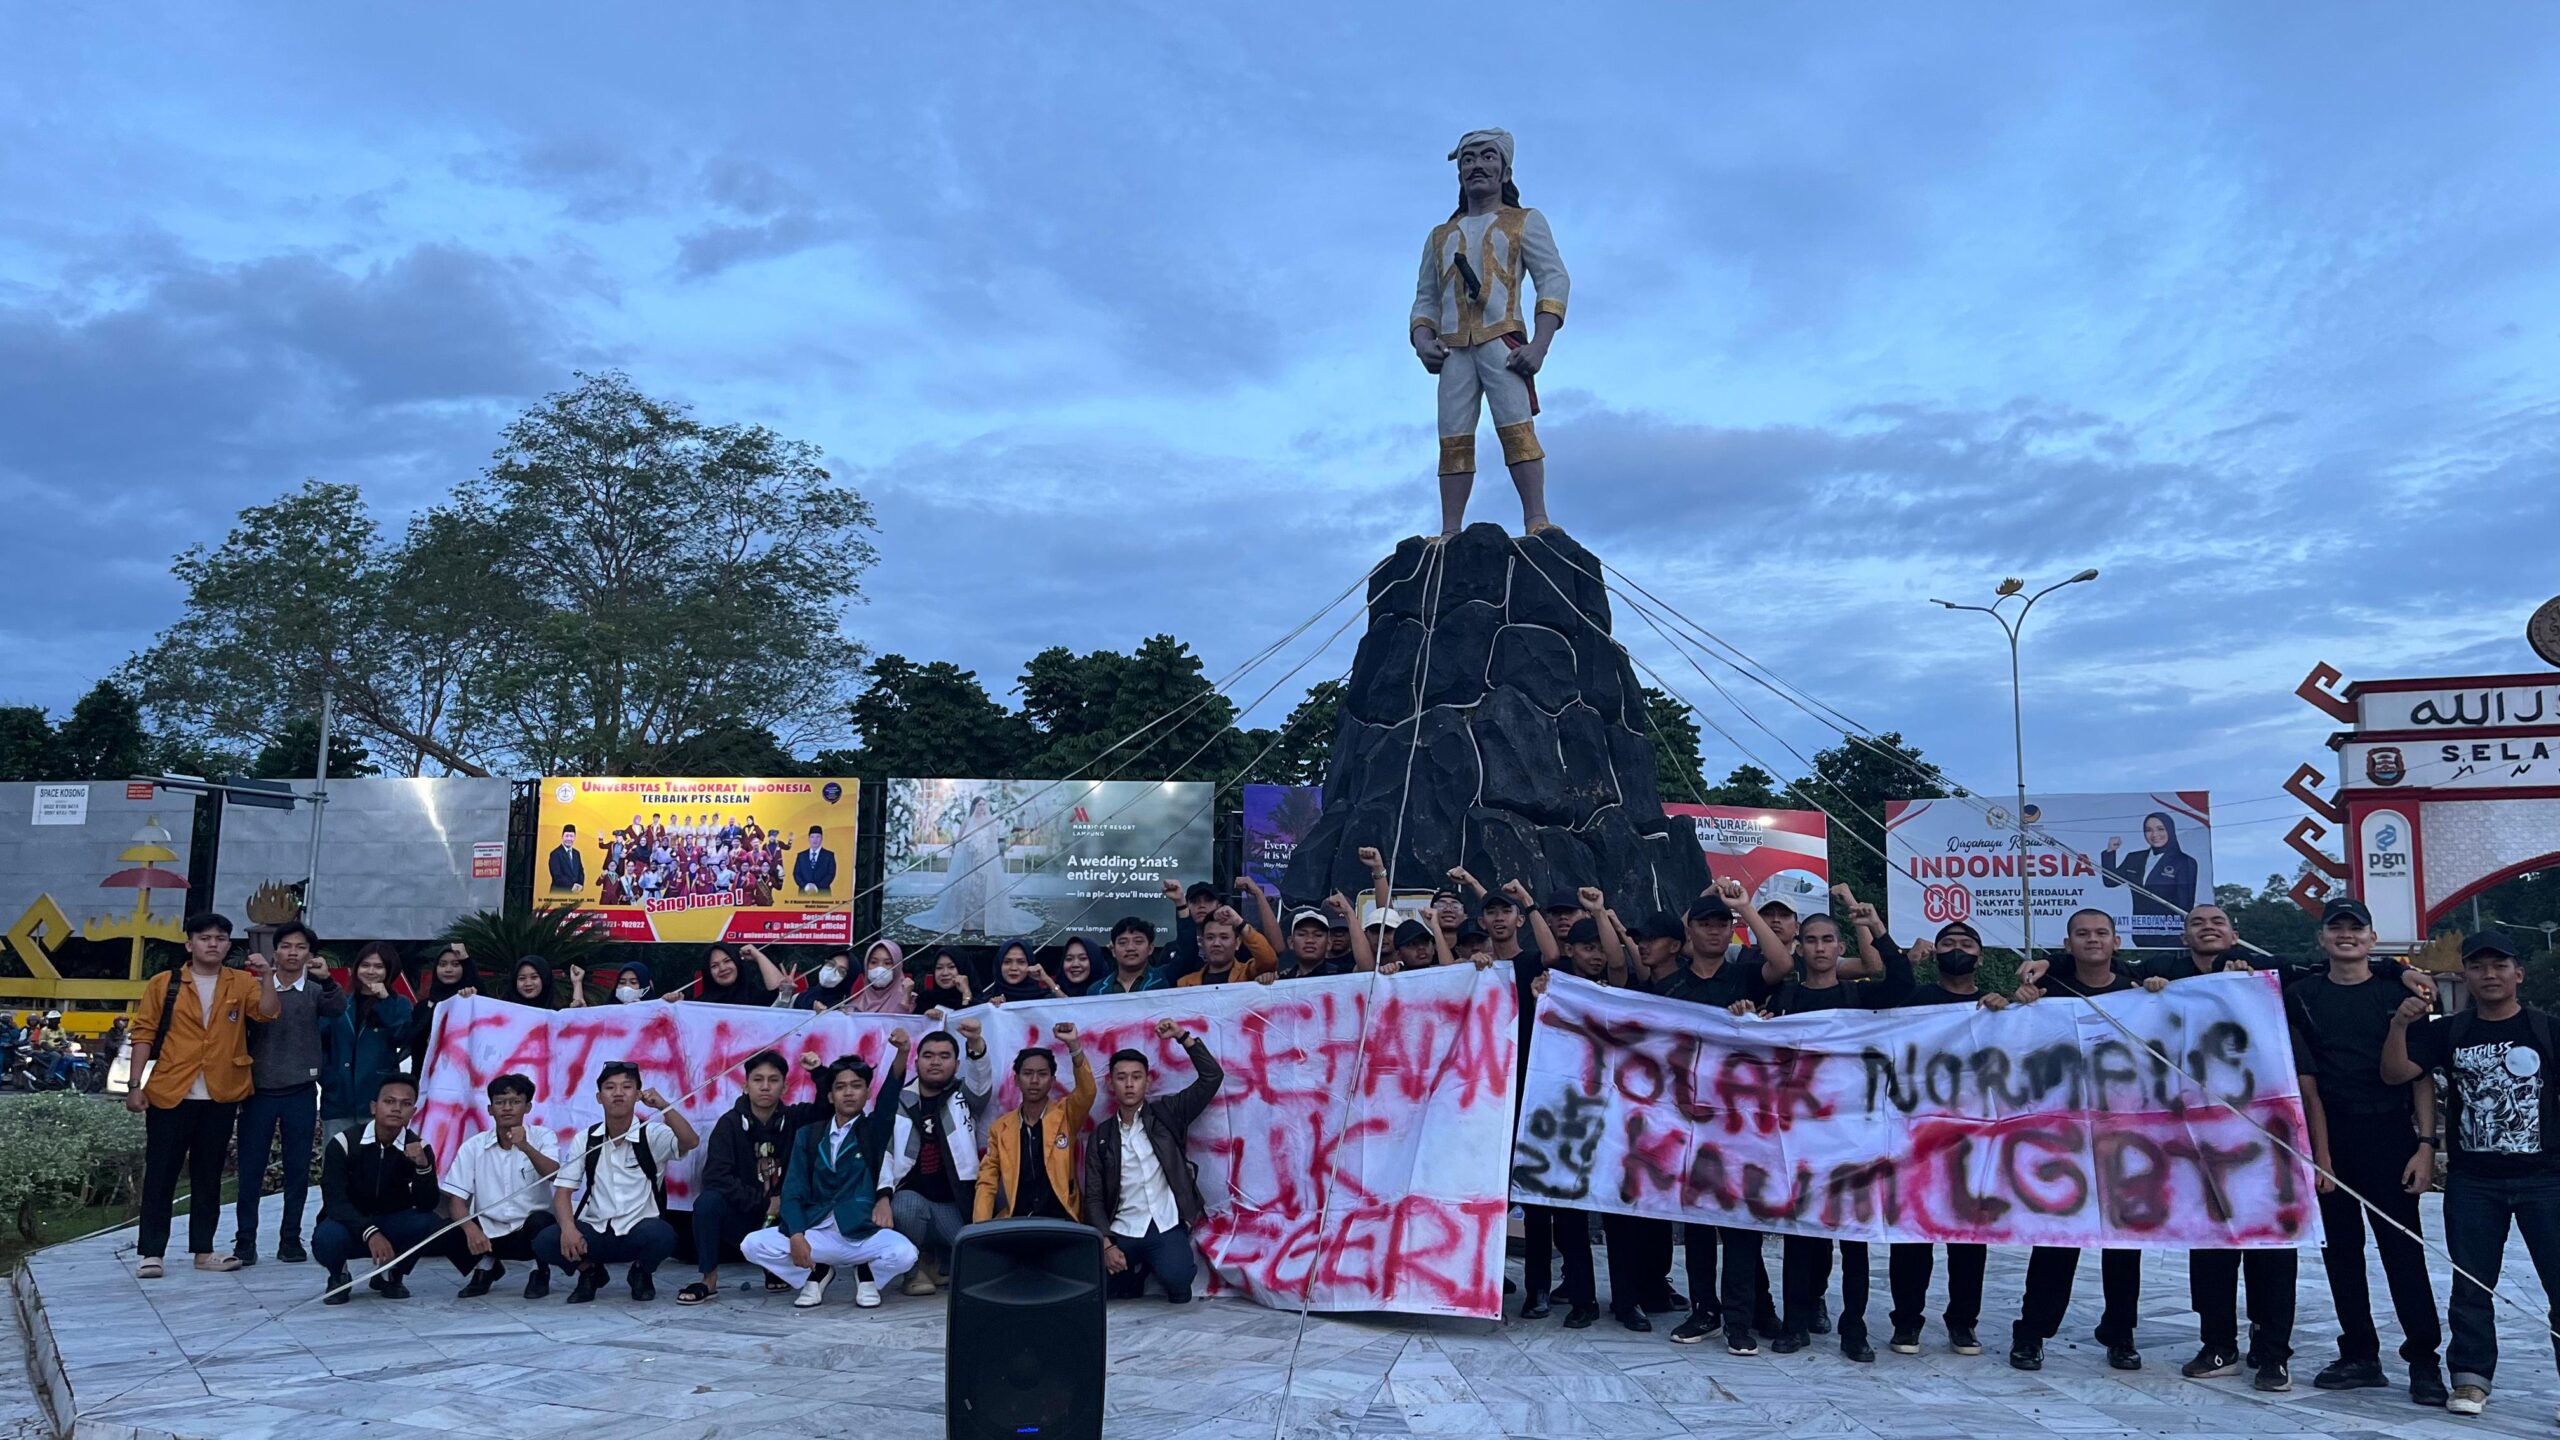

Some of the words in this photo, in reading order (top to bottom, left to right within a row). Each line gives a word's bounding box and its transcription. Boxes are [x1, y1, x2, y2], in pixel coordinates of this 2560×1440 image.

[40, 788, 59, 798] SPACE
[60, 788, 86, 798] KOSONG
[582, 782, 660, 792] UNIVERSITAS
[665, 782, 738, 792] TEKNOKRAT
[742, 783, 812, 793] INDONESIA
[642, 794, 688, 804] TERBAIK
[691, 794, 712, 804] PTS
[714, 794, 750, 804] ASEAN
[1713, 818, 1762, 832] SURAPATI
[1264, 839, 1290, 852] Every
[1717, 833, 1763, 846] Lampung
[1263, 850, 1271, 860] it
[1272, 851, 1280, 860] is
[2368, 852, 2406, 869] pgn
[1067, 855, 1077, 867] A
[1080, 855, 1137, 870] wedding
[1140, 855, 1179, 868] that's
[1910, 852, 2096, 879] INDONESIA
[1066, 869, 1119, 884] entirely
[1121, 872, 1160, 884] yours
[1115, 890, 1138, 900] you'll
[1975, 889, 2021, 897] BERSATU
[646, 897, 686, 913] Sang
[689, 893, 733, 909] Juara
[1923, 884, 1971, 923] 80
[1976, 909, 2031, 917] INDONESI
[2034, 908, 2063, 916] MAJU
[1539, 1008, 1836, 1135] TOLAK
